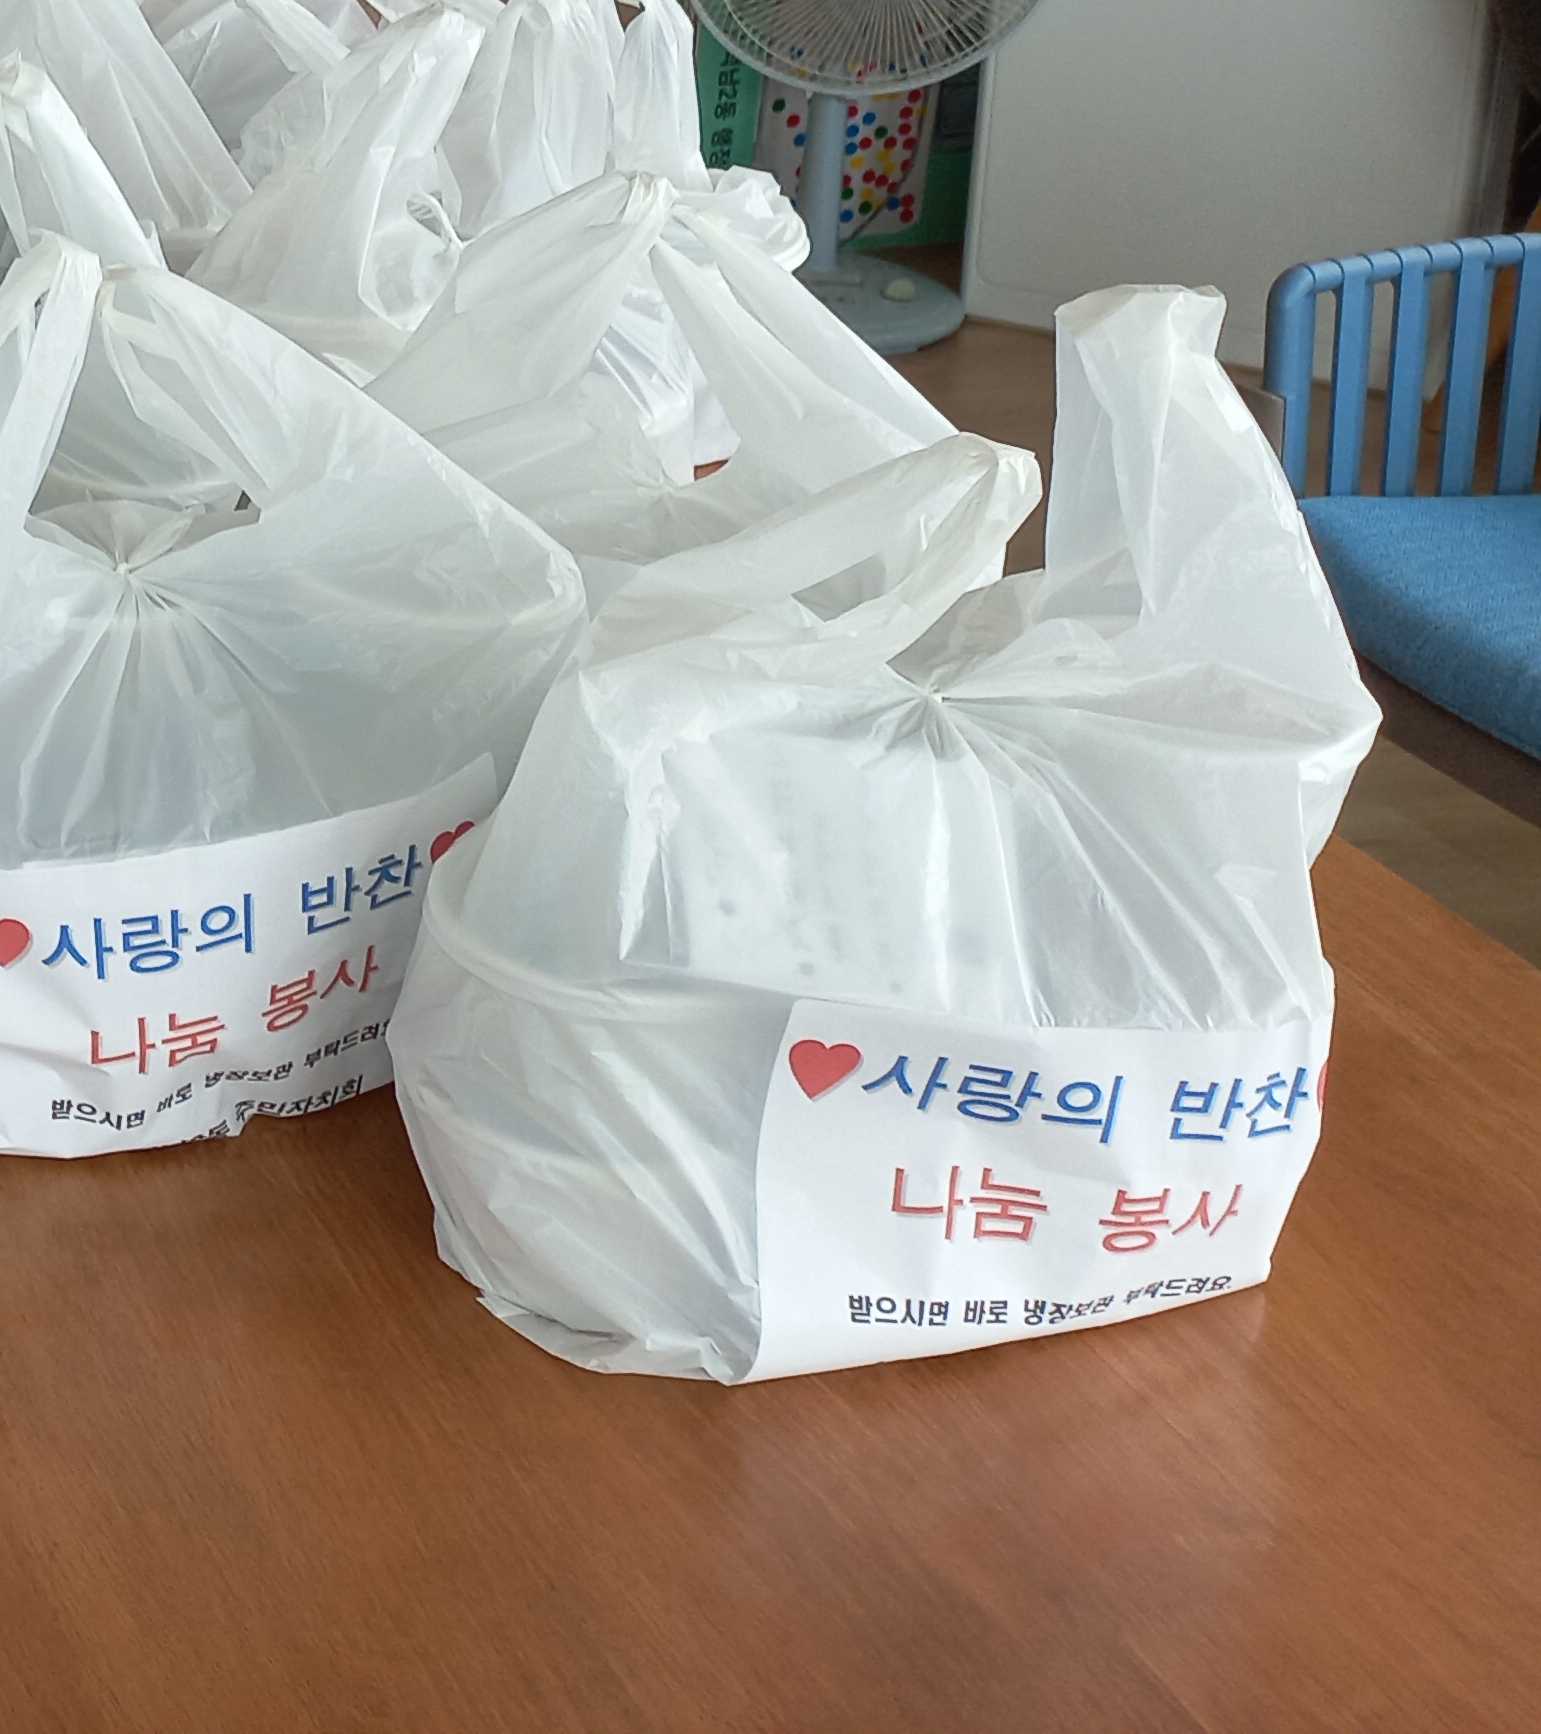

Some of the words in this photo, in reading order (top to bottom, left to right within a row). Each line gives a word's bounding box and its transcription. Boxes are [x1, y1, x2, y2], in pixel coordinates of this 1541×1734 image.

[41, 892, 254, 981] 사랑의
[300, 843, 423, 936] 반찬
[89, 1011, 227, 1076] 나눔
[261, 943, 380, 1034] 봉사
[51, 1099, 147, 1132] 받으시면
[861, 1054, 1125, 1145] 사랑의
[1169, 1066, 1311, 1142] 반찬
[890, 1164, 1049, 1243] 나눔
[1097, 1181, 1244, 1255] 봉사
[847, 1293, 950, 1328] 받으시면
[962, 1299, 1009, 1326] 바로
[1022, 1294, 1115, 1327] 냉장보관
